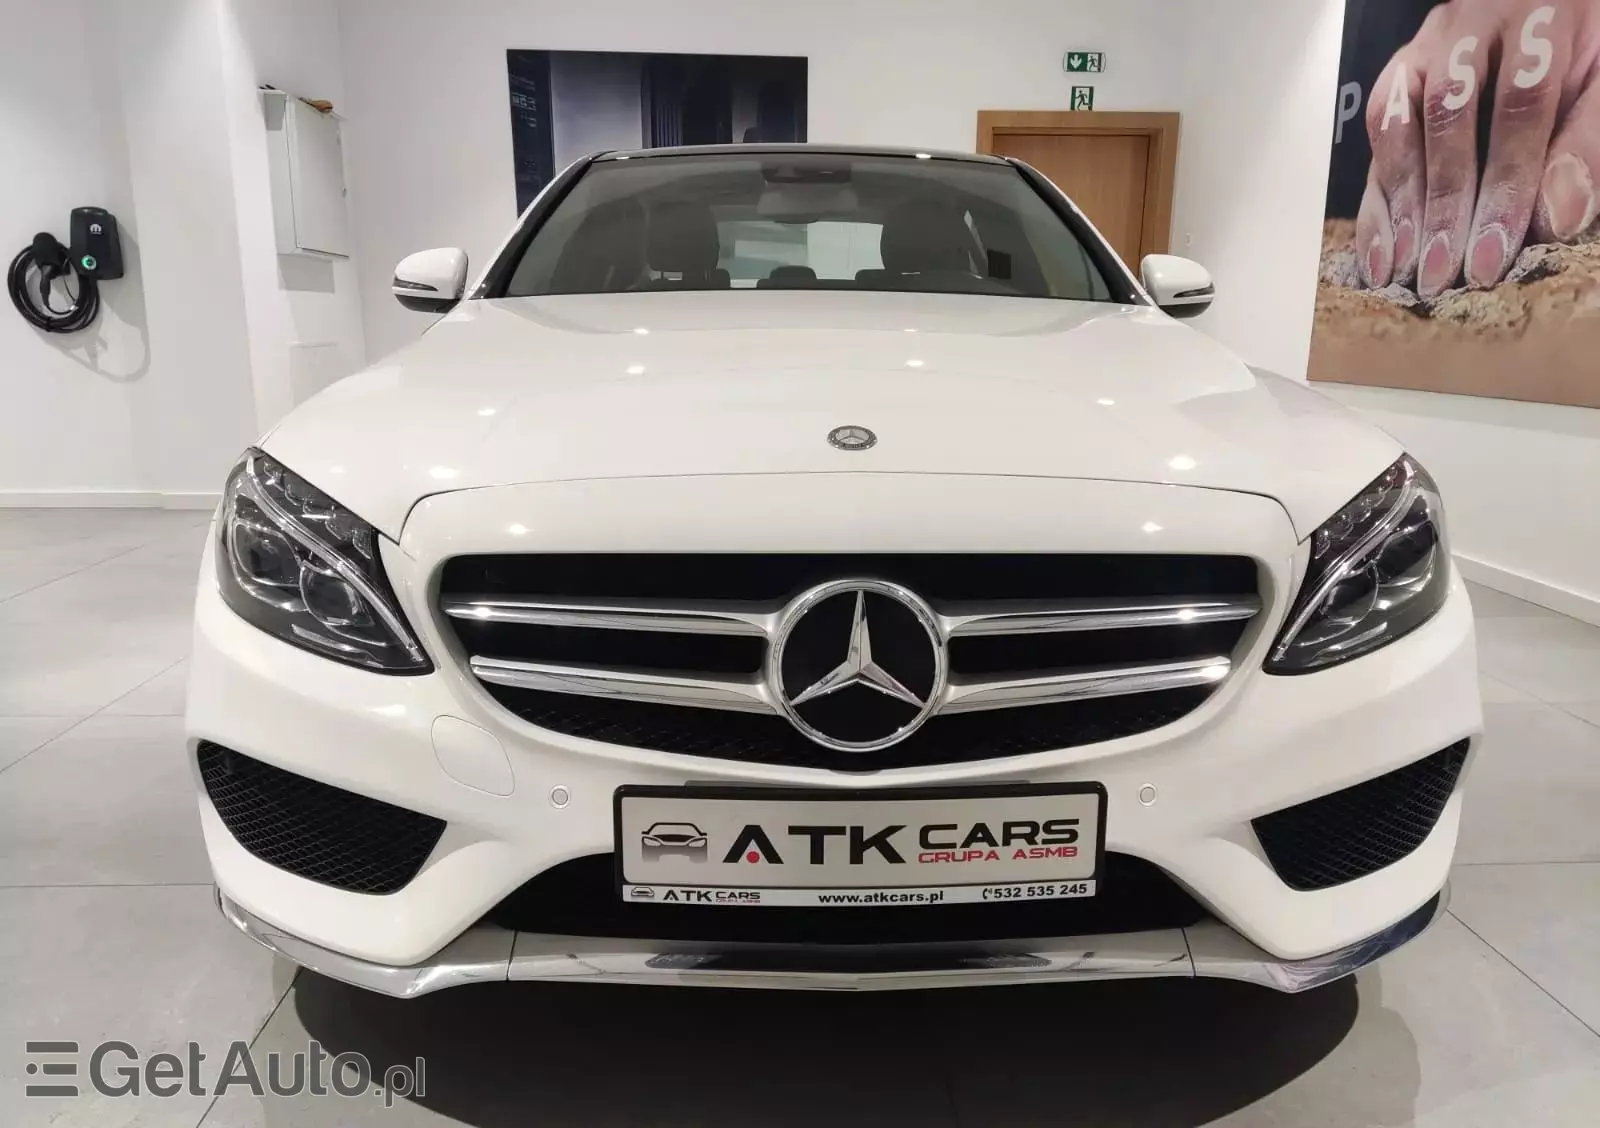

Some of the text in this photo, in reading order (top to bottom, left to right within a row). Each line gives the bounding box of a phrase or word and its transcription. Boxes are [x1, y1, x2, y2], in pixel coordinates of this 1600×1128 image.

[722, 818, 1079, 865] ATK CARS
[918, 846, 1078, 864] GRUPA ASMB
[663, 889, 712, 902] ATK
[715, 891, 761, 900] CARS
[818, 890, 944, 904] www.atkcars.pl
[994, 883, 1088, 899] 532 535 245
